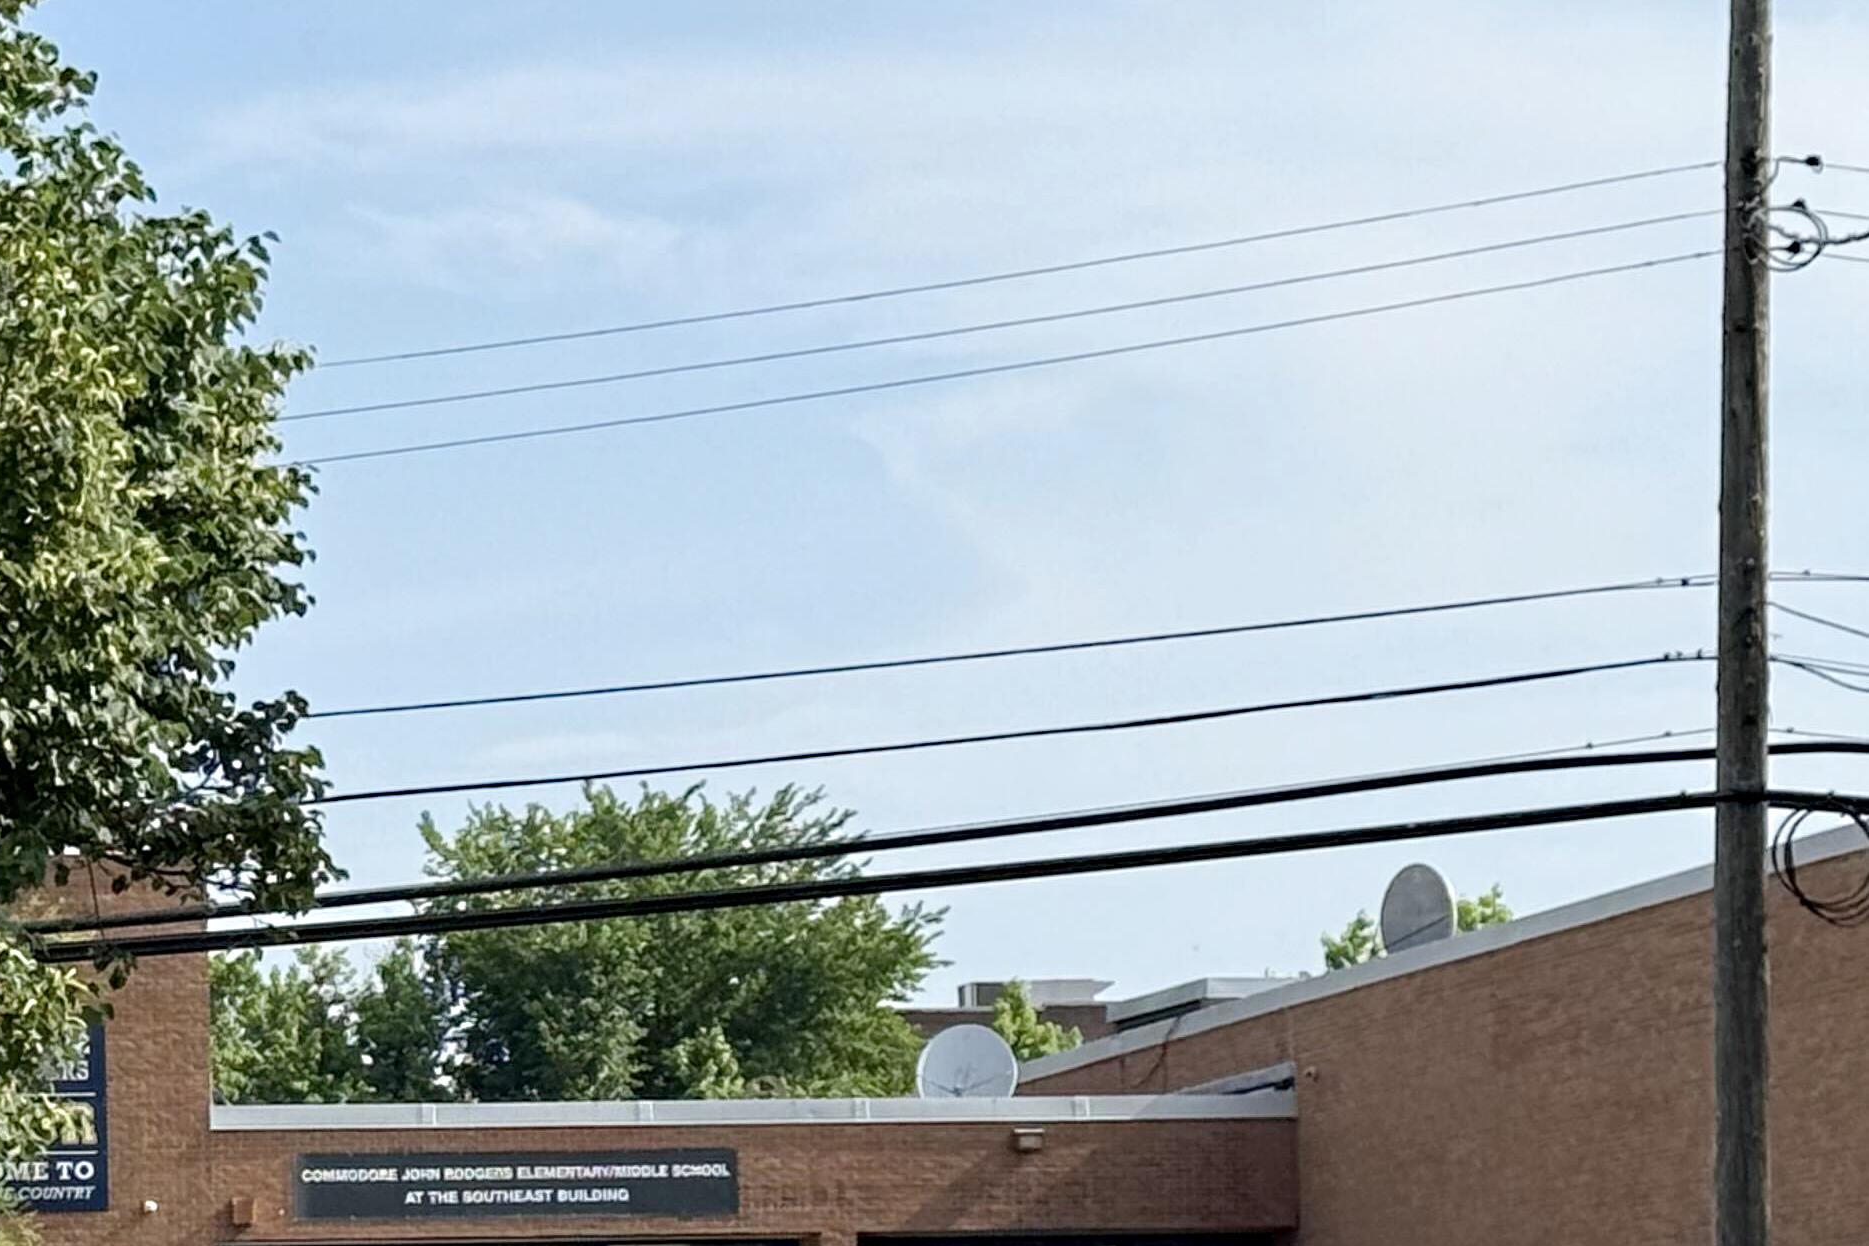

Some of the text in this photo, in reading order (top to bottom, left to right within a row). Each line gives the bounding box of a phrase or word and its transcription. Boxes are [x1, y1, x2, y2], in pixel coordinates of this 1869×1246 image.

[55, 1160, 95, 1181] TO
[301, 1167, 398, 1183] COMMODORE
[401, 1167, 441, 1182] JOHN
[671, 1163, 730, 1178] SCHOOL
[17, 1186, 96, 1200] COUNTRY
[404, 1187, 630, 1205] AT THE SOUTHEAST BUILDING
